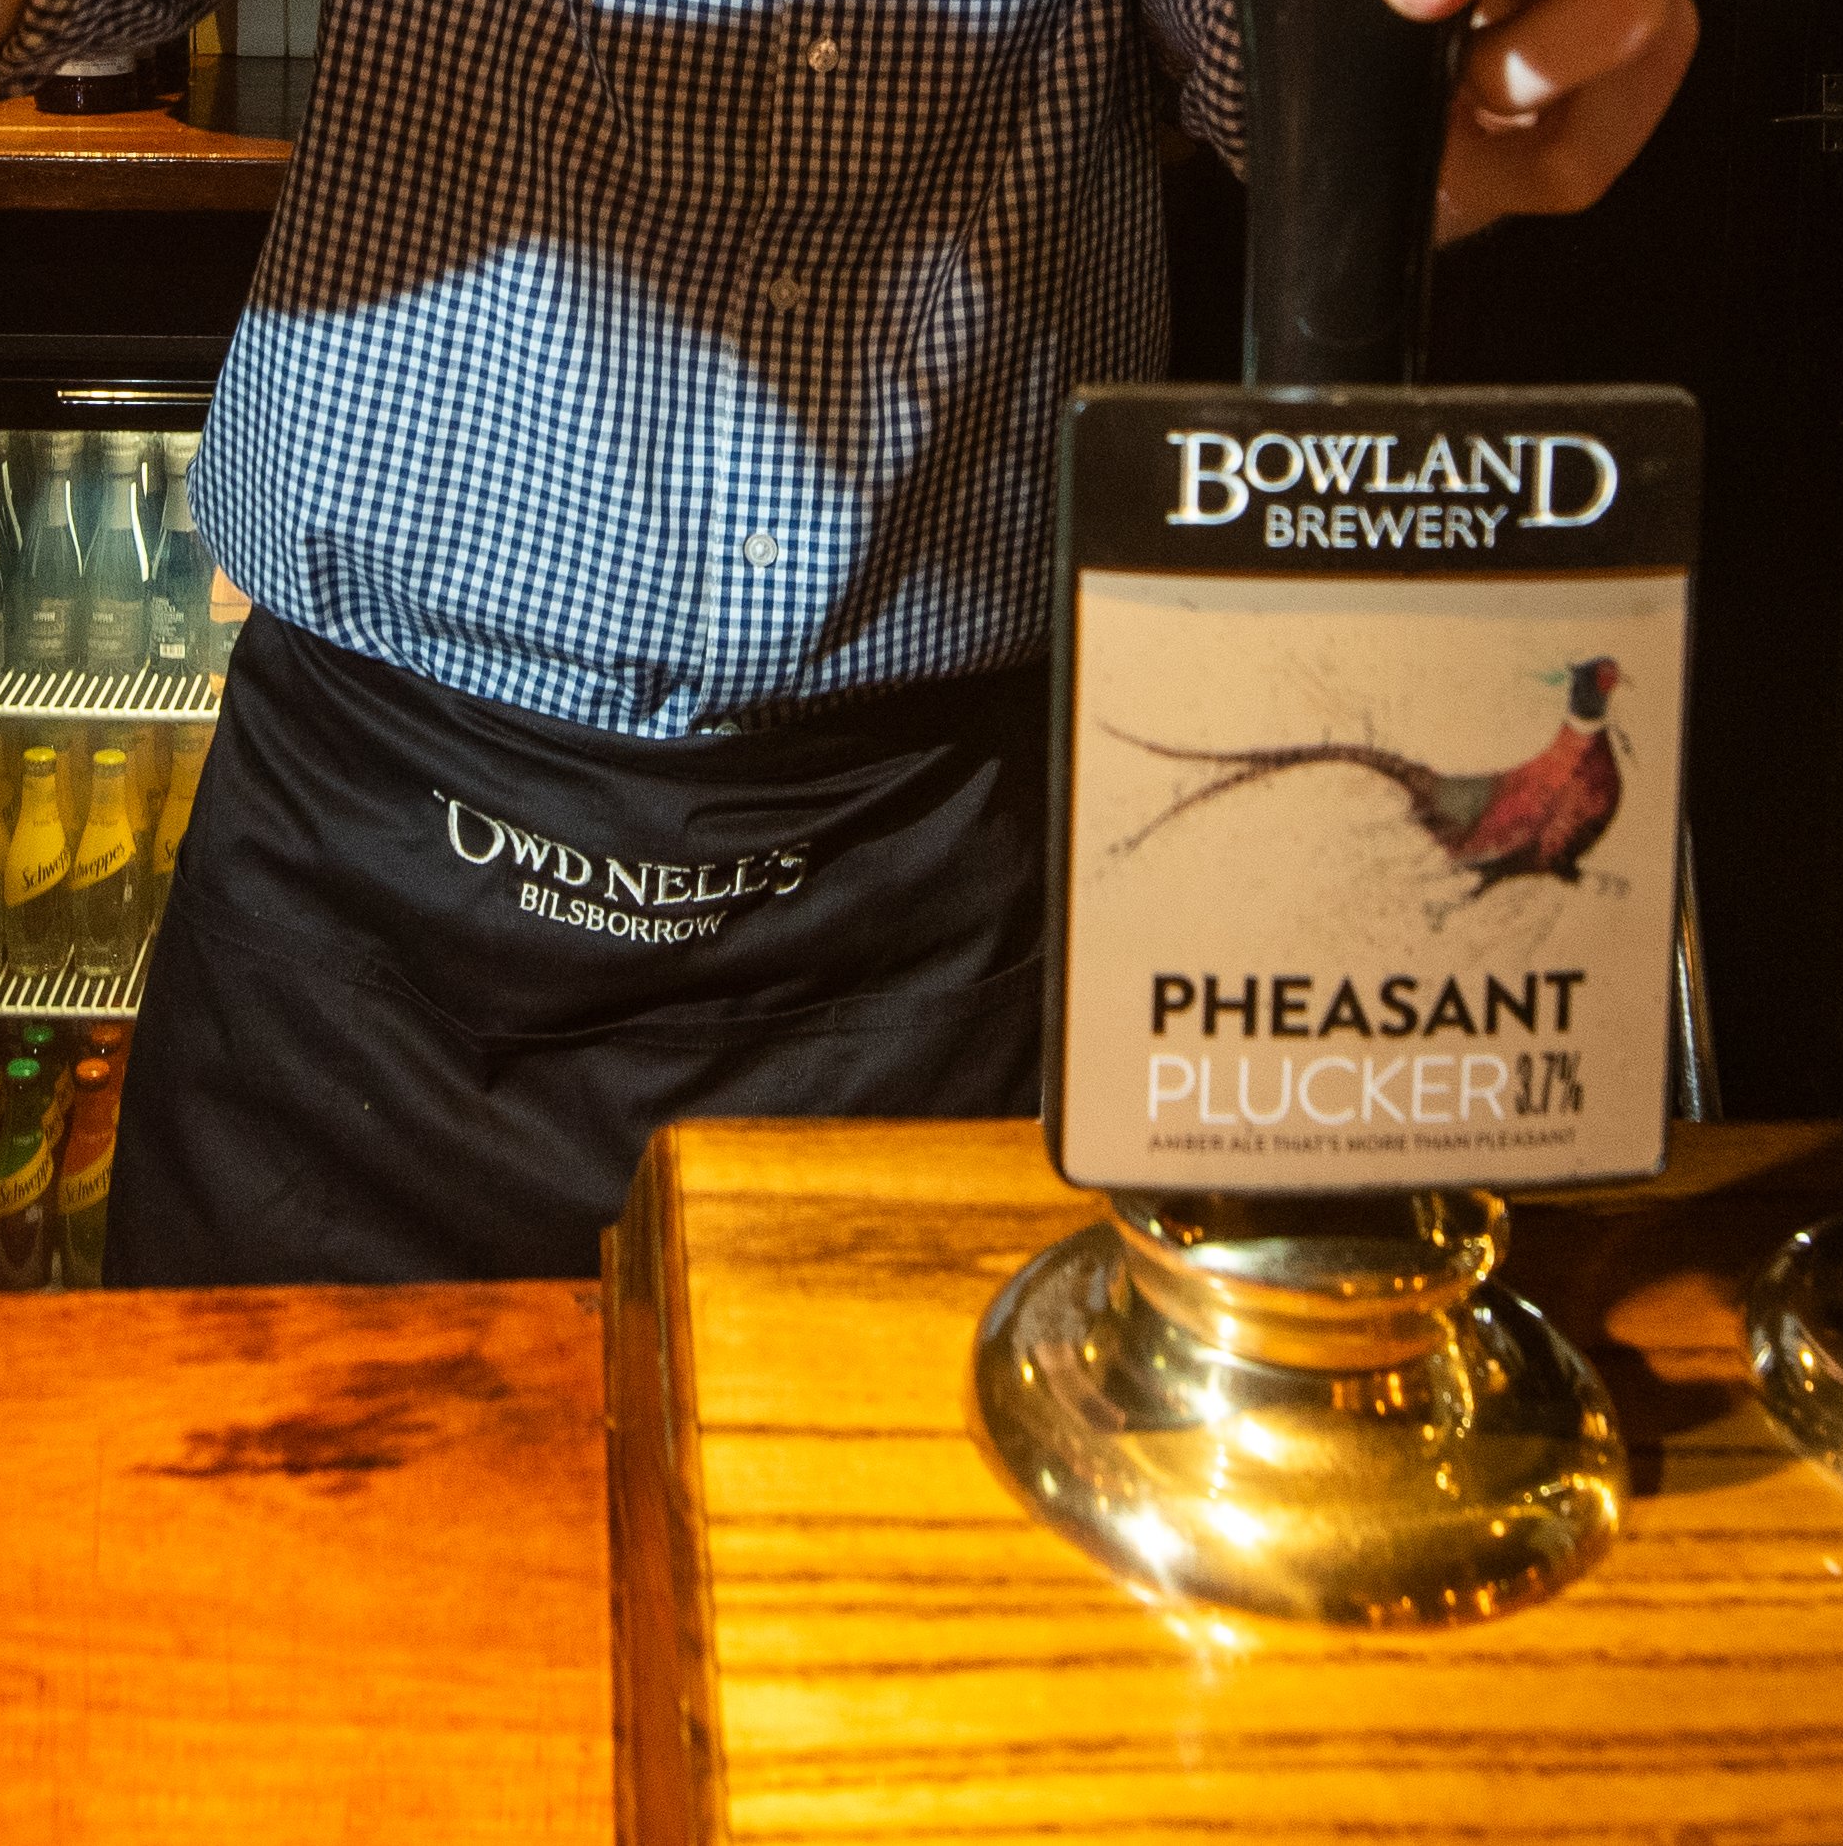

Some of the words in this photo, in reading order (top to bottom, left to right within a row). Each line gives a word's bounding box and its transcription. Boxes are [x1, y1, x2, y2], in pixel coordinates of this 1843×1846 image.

[1166, 430, 1619, 529] BOWLAND
[1264, 504, 1509, 550] BREWERY
[603, 843, 810, 907] NELL'S
[519, 881, 728, 945] BILSBORROW
[1151, 969, 1586, 1040] PHEASANT
[1148, 1053, 1511, 1127] PLUCKER
[1514, 1049, 1585, 1118] 3.7%
[1148, 1135, 1226, 1153] AMBER
[1231, 1135, 1266, 1155] ALE
[1272, 1135, 1340, 1154] THAT'S
[1346, 1134, 1408, 1153] MORE
[1413, 1133, 1472, 1152] THAN
[1474, 1127, 1577, 1151] PLEASANT
